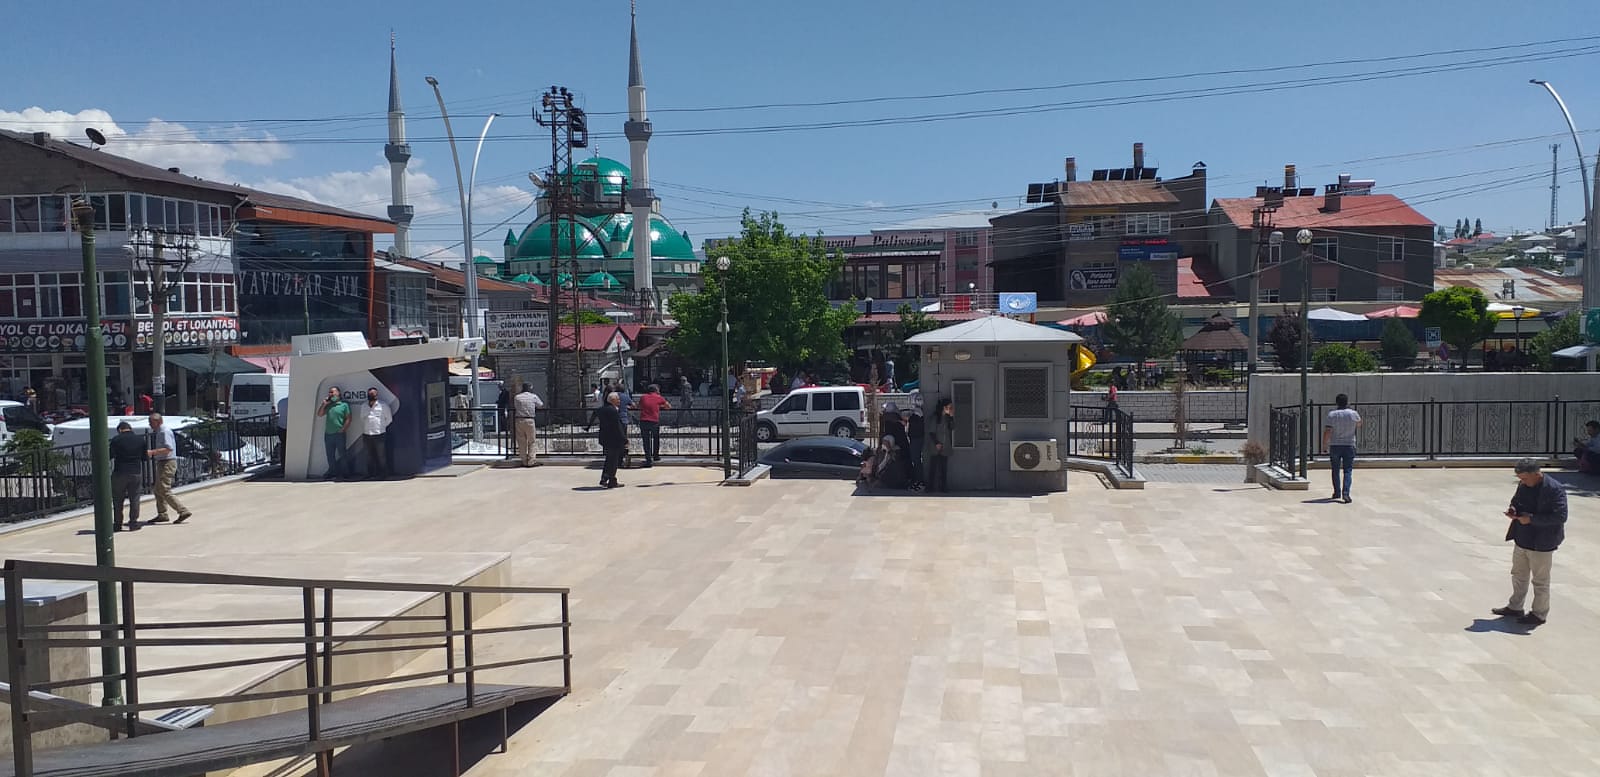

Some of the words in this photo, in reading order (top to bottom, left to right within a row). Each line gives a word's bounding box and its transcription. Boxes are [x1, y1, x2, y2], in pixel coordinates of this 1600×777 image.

[239, 271, 322, 296] YAVUZLAR
[28, 324, 45, 335] ET
[49, 322, 125, 335] LOKAASI
[137, 321, 174, 332] BEOL
[176, 320, 187, 331] ET
[190, 319, 236, 330] LOKANTASI
[343, 390, 367, 400] QNB
